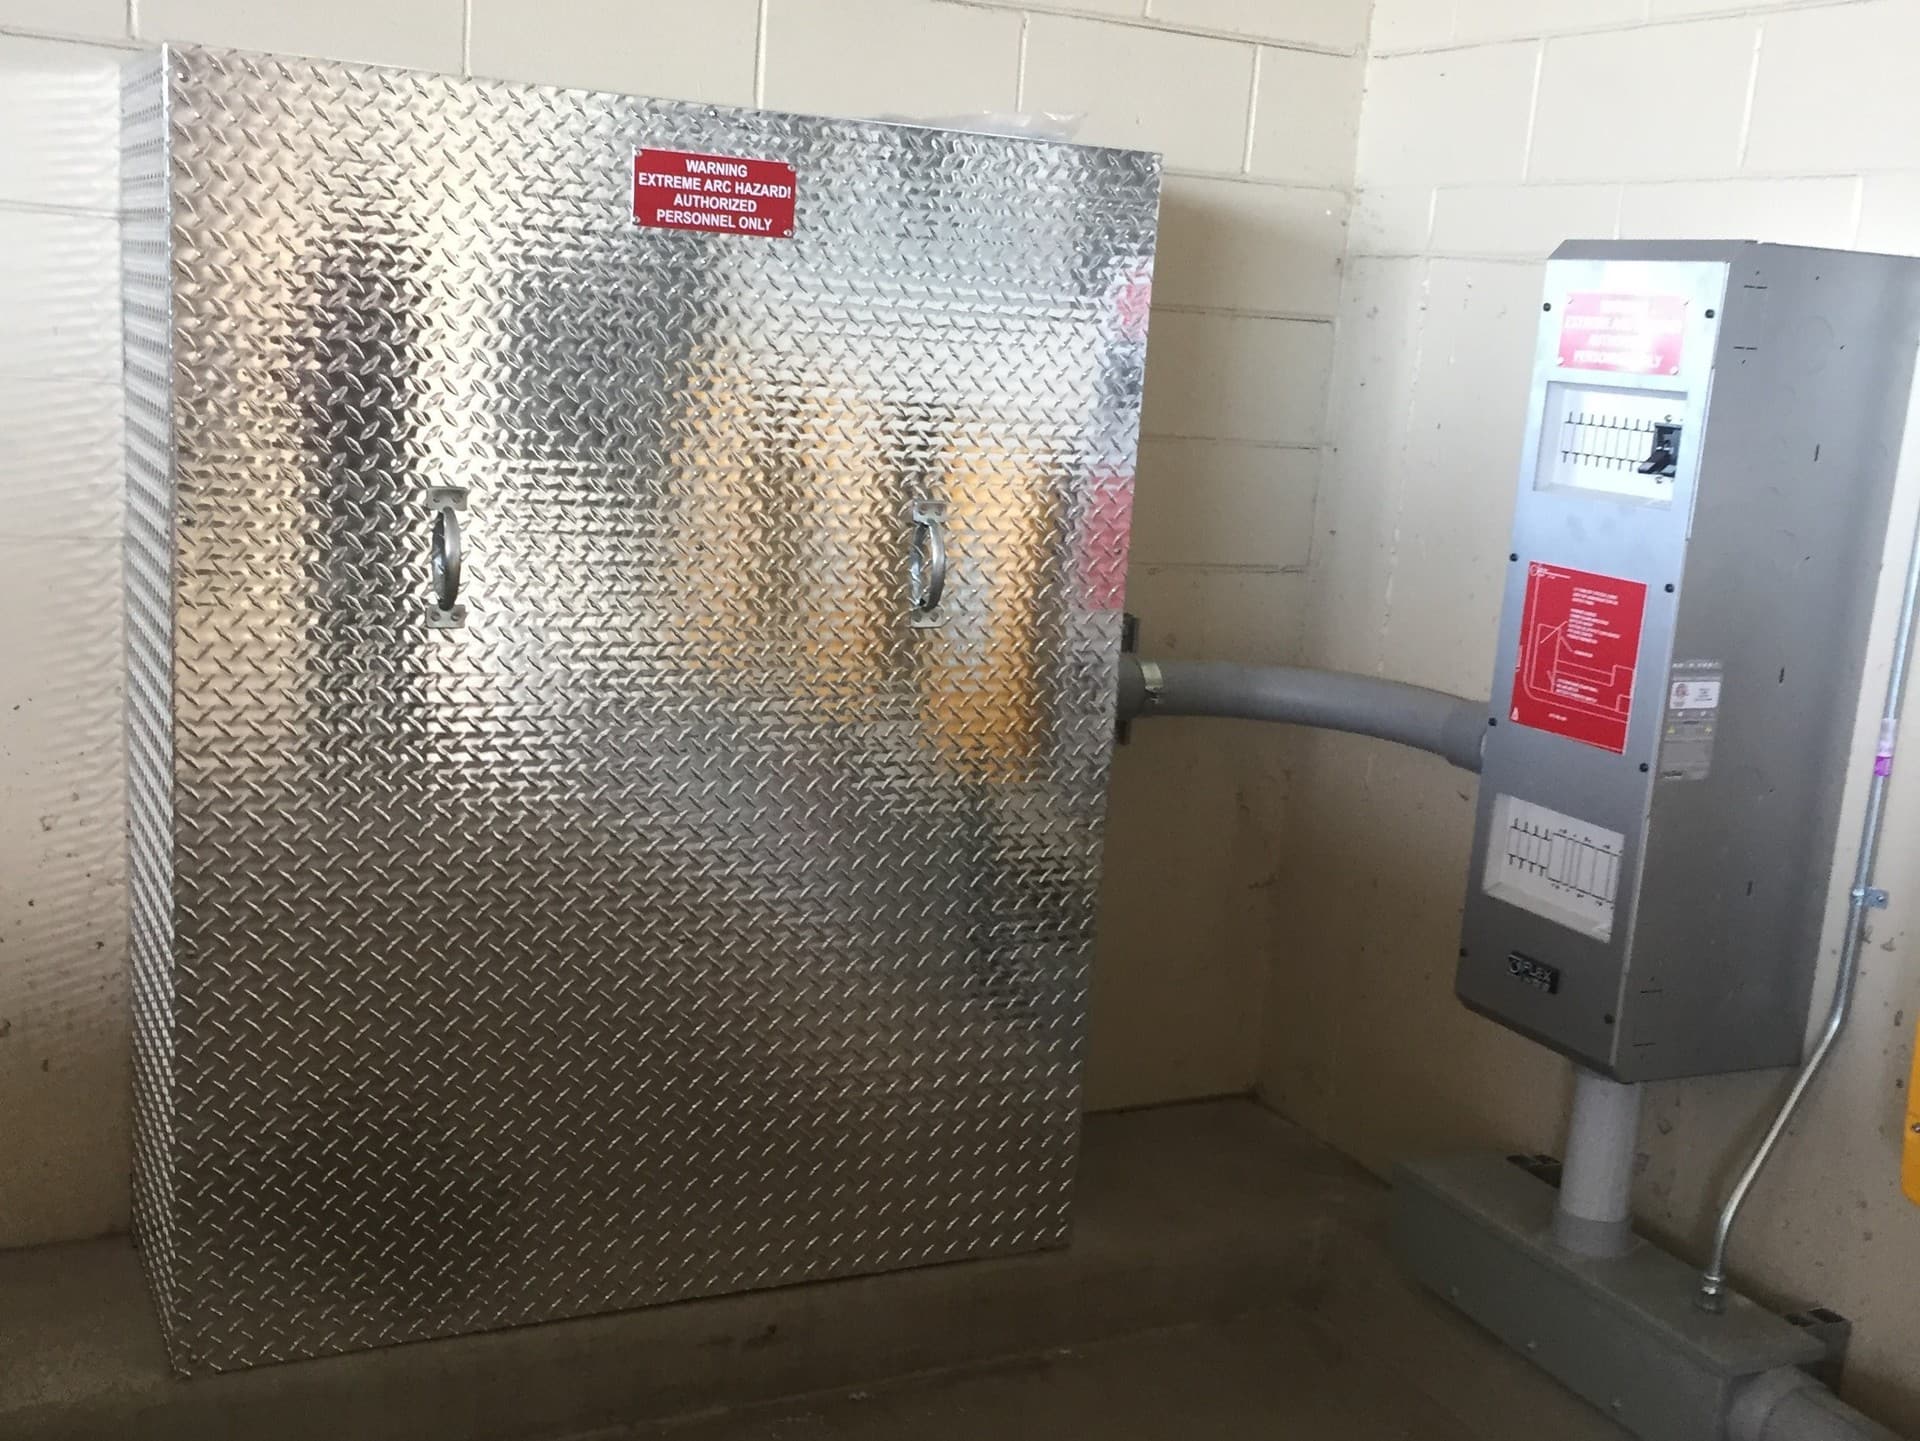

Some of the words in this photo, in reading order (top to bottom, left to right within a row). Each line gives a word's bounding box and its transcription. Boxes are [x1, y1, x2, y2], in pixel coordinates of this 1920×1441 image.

[685, 159, 748, 178] WARNING
[638, 172, 701, 191] EXTREME
[703, 179, 732, 194] ARC
[735, 181, 792, 199] HAZARD!
[673, 193, 757, 213] AUTHORIZED
[656, 208, 736, 229] PERSONNEL
[738, 216, 773, 231] ONLY
